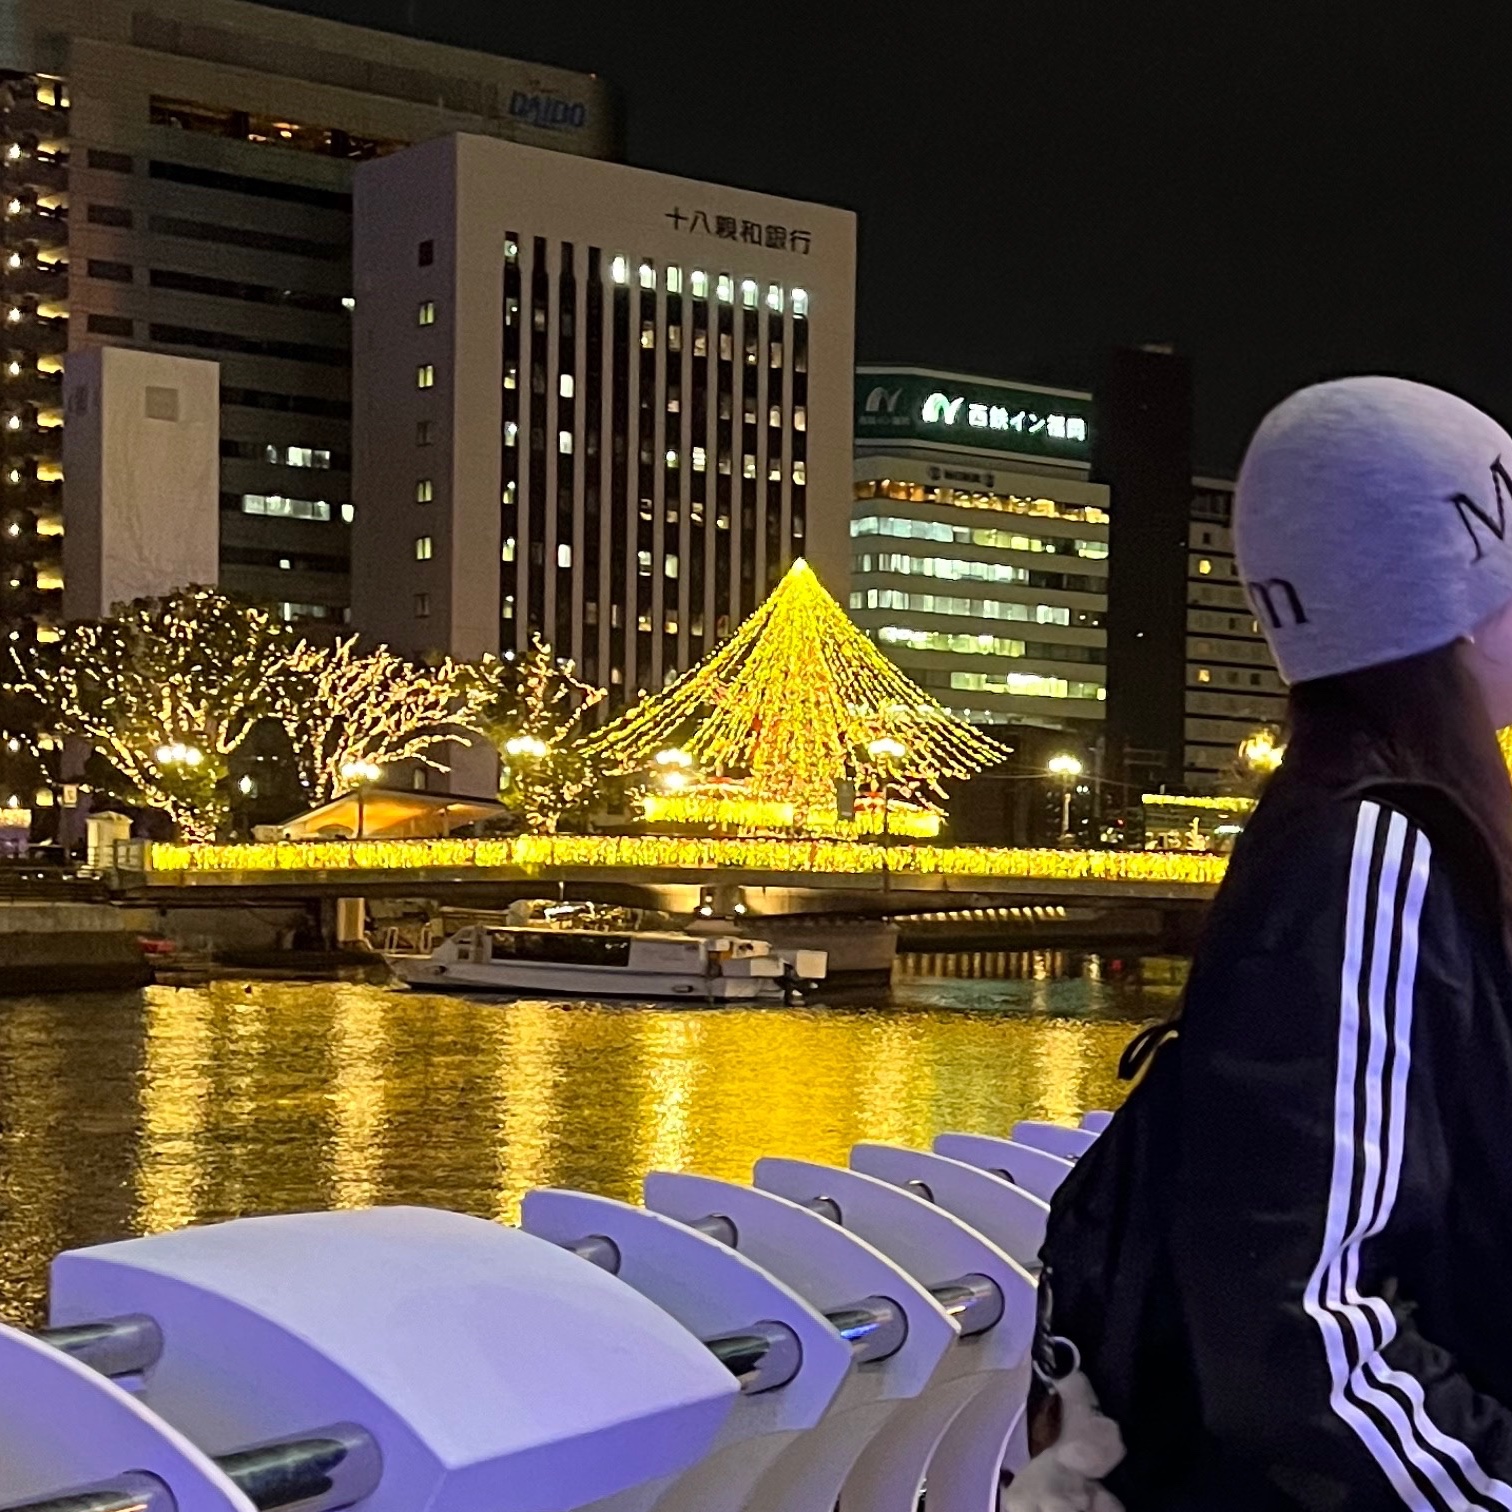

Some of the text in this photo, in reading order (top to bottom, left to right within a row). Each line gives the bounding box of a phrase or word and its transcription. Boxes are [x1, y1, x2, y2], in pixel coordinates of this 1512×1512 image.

[665, 206, 811, 255] 十八親和銀行
